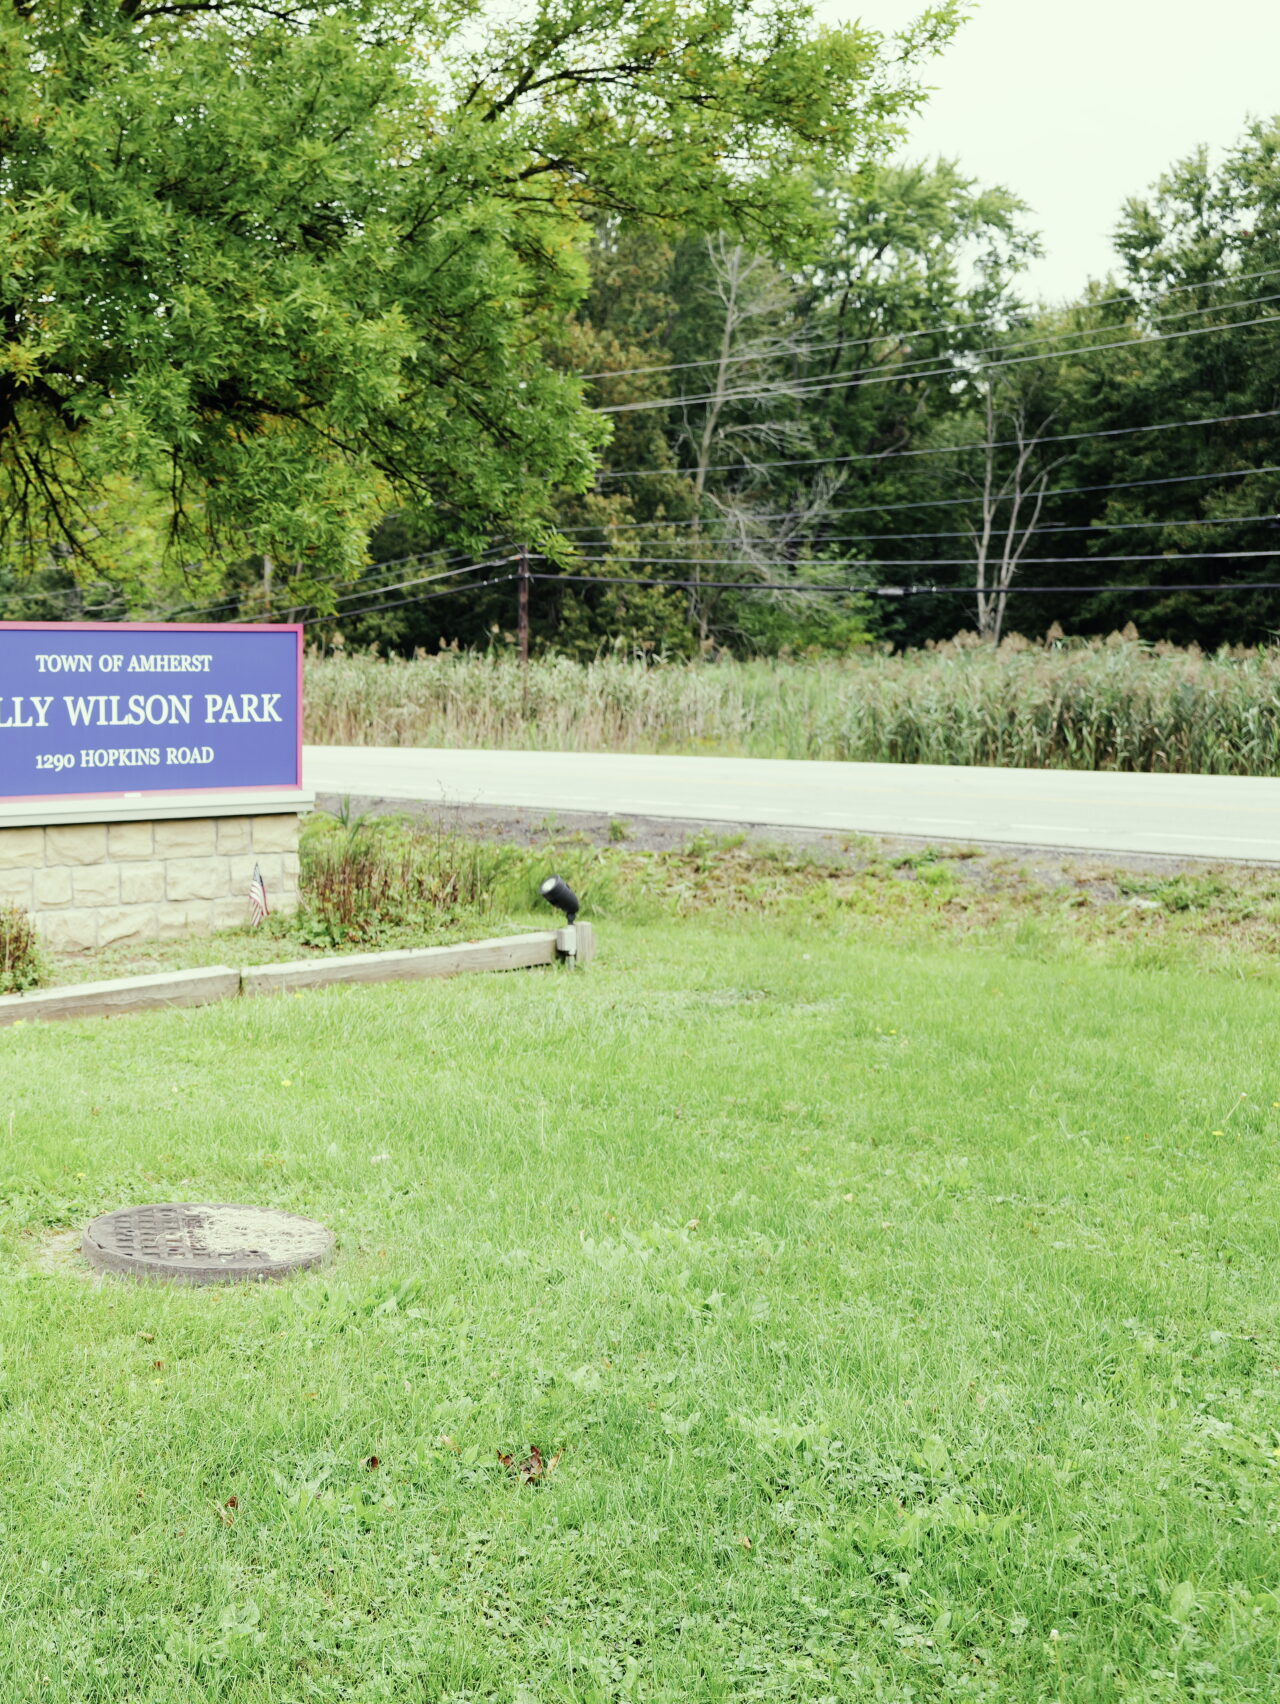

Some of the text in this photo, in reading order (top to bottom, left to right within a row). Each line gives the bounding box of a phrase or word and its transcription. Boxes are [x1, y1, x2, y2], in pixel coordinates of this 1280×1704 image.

[35, 654, 212, 673] TOWN OF AMHERST
[63, 694, 193, 727] WILSON
[204, 693, 282, 724] PARK
[35, 746, 214, 772] 1290 HOPKINS ROAD
